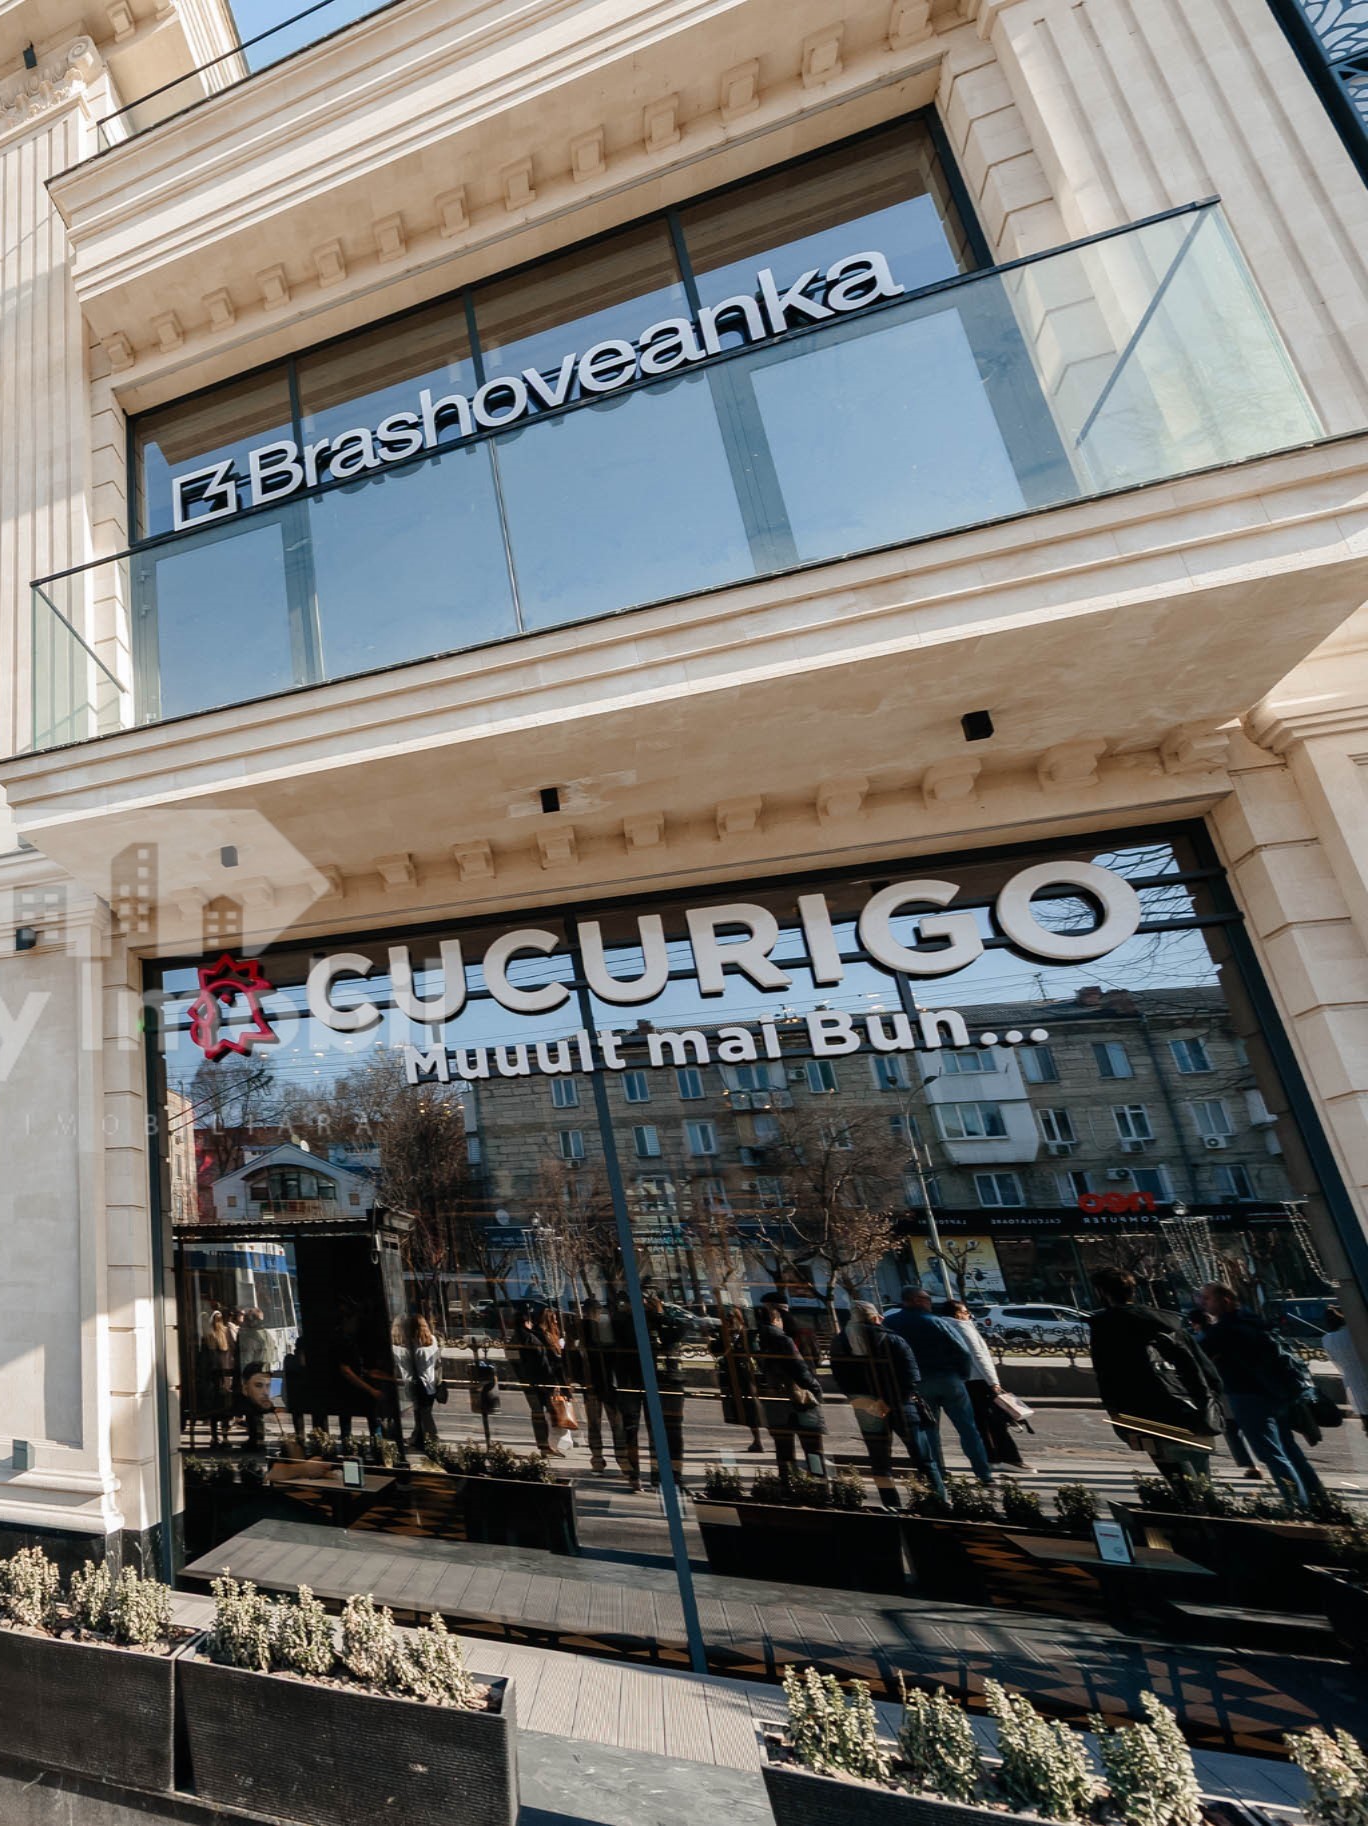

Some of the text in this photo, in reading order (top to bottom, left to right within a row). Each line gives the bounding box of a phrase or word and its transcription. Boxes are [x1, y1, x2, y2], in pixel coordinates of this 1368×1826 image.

[250, 250, 904, 505] Brashoveanka
[305, 860, 1141, 1031] CUCURIGO
[404, 1008, 1050, 1085] Muuult mai Bun...
